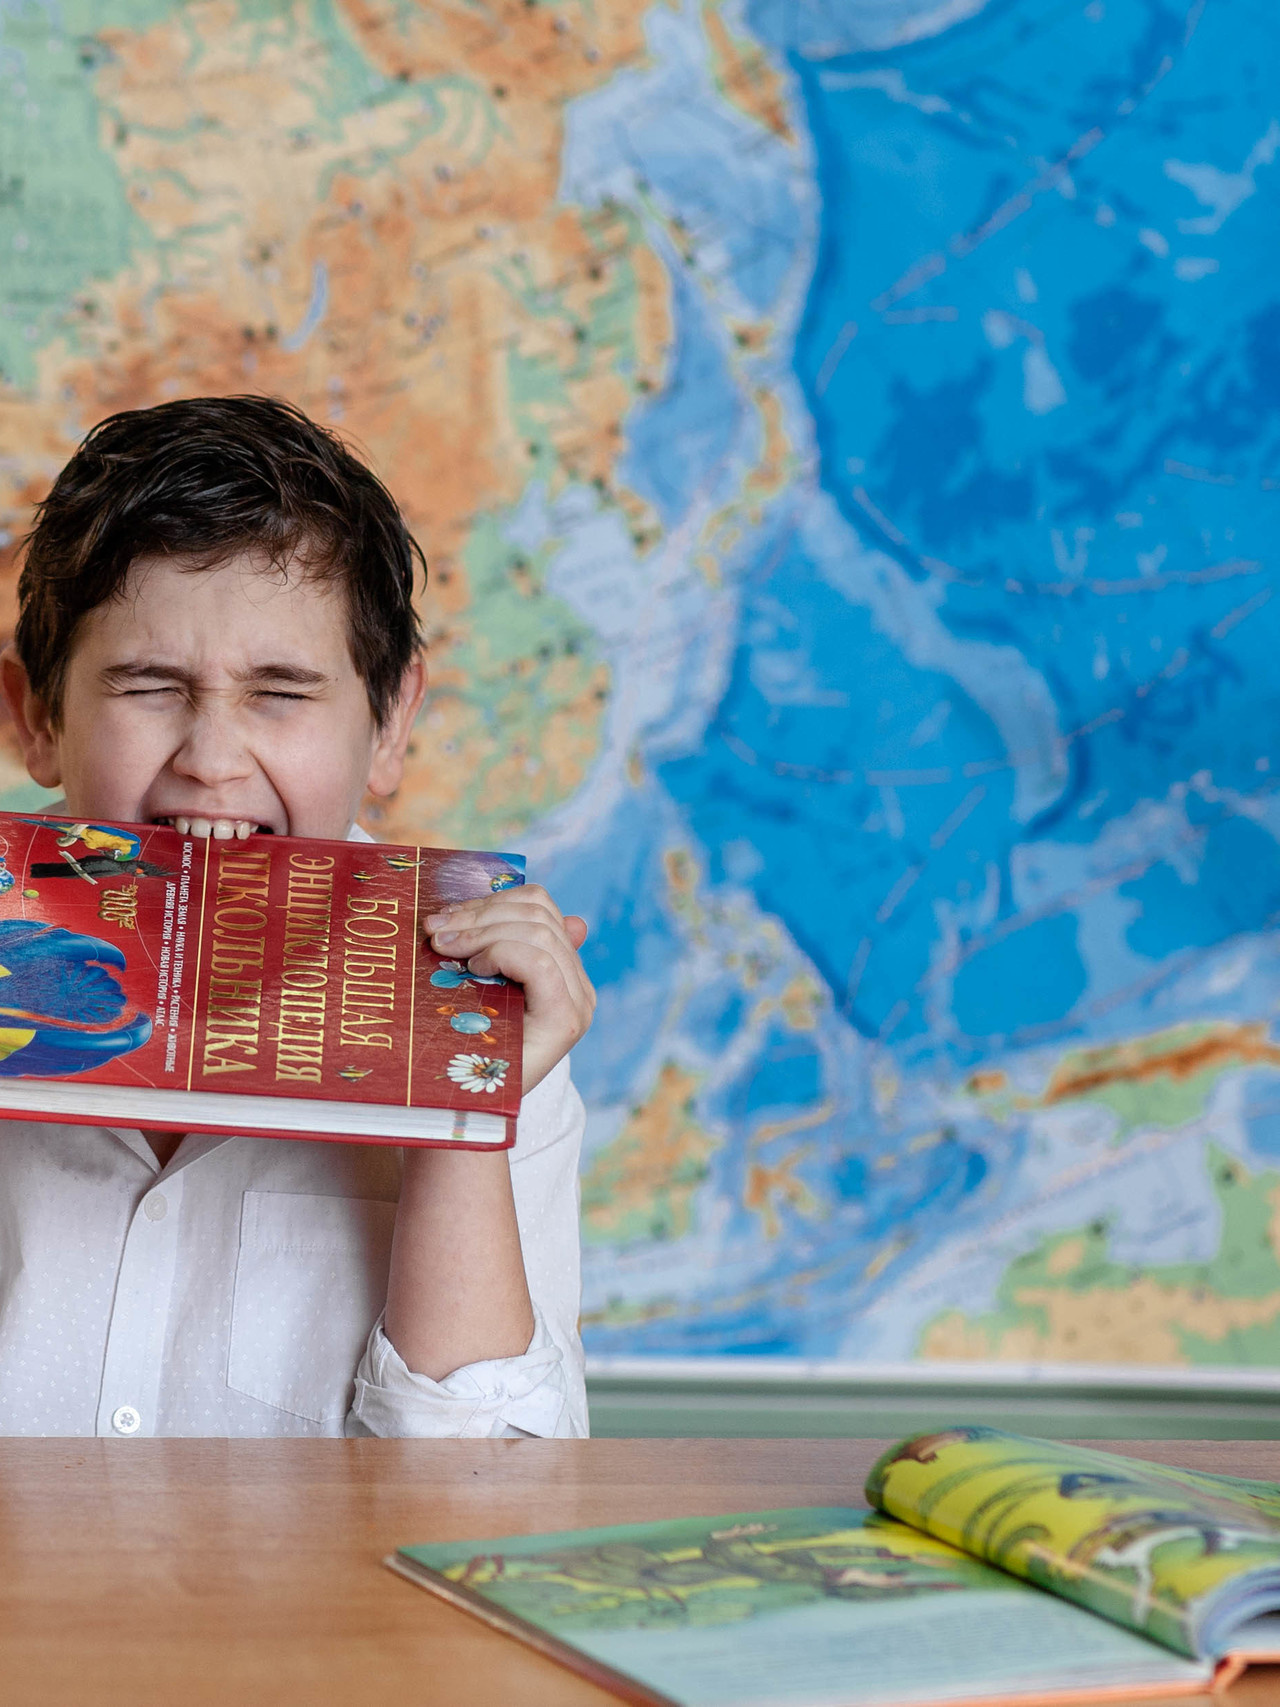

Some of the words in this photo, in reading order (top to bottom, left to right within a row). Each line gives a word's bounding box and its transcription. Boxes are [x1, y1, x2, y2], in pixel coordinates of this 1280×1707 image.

[182, 841, 193, 870] КОСМОС
[165, 881, 176, 909] ДРЕВНЯЯ
[179, 875, 190, 903] ПЛАНЕТА
[162, 910, 173, 940] ИСТОРИЯ
[177, 904, 188, 925] ЗЕМЛЯ
[174, 931, 186, 953] НАУКА
[160, 946, 171, 970] НОВАЯ
[203, 848, 271, 1076] ШКОЛЬНИКА
[267, 853, 335, 1083] ЭНЦИКЛОПЕДИЯ
[340, 895, 399, 1050] БОЛЬШАЯ
[157, 969, 169, 1000] ИСТОРИЯ
[172, 959, 183, 988] ТЕХНИКА
[155, 1006, 165, 1027] АТЛАС
[169, 995, 180, 1027] РАСТЕНИЯ
[165, 1033, 177, 1073] ЖИВОТНЫЕ
